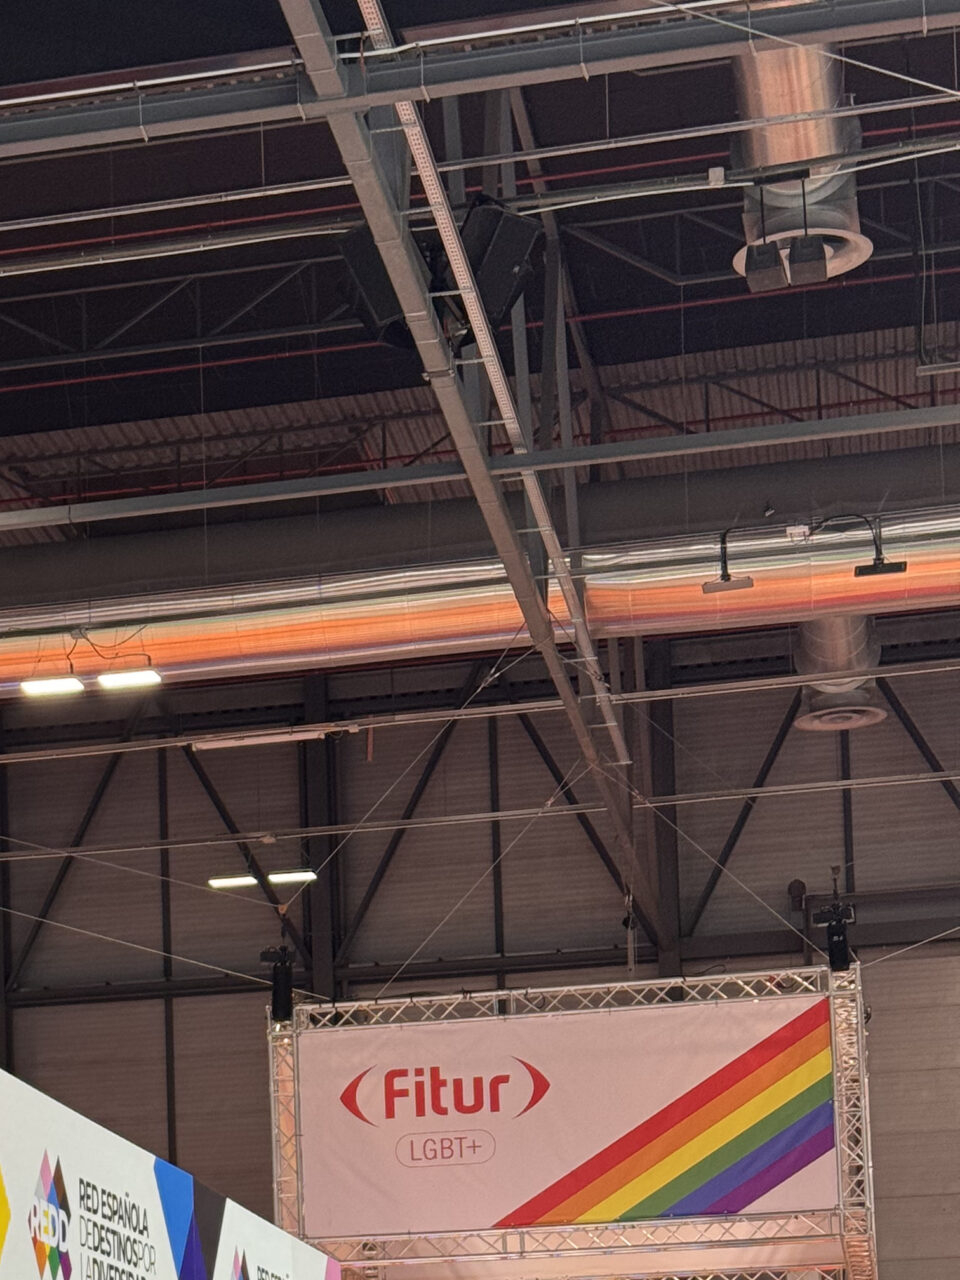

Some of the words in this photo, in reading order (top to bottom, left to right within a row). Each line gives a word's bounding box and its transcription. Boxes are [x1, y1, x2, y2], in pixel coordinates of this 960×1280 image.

[384, 1066, 510, 1119] Fitur
[410, 1137, 482, 1161] LGBT+
[30, 1197, 70, 1253] REDD
[79, 1177, 99, 1215] RED
[101, 1188, 149, 1239] ESPAÑOLA
